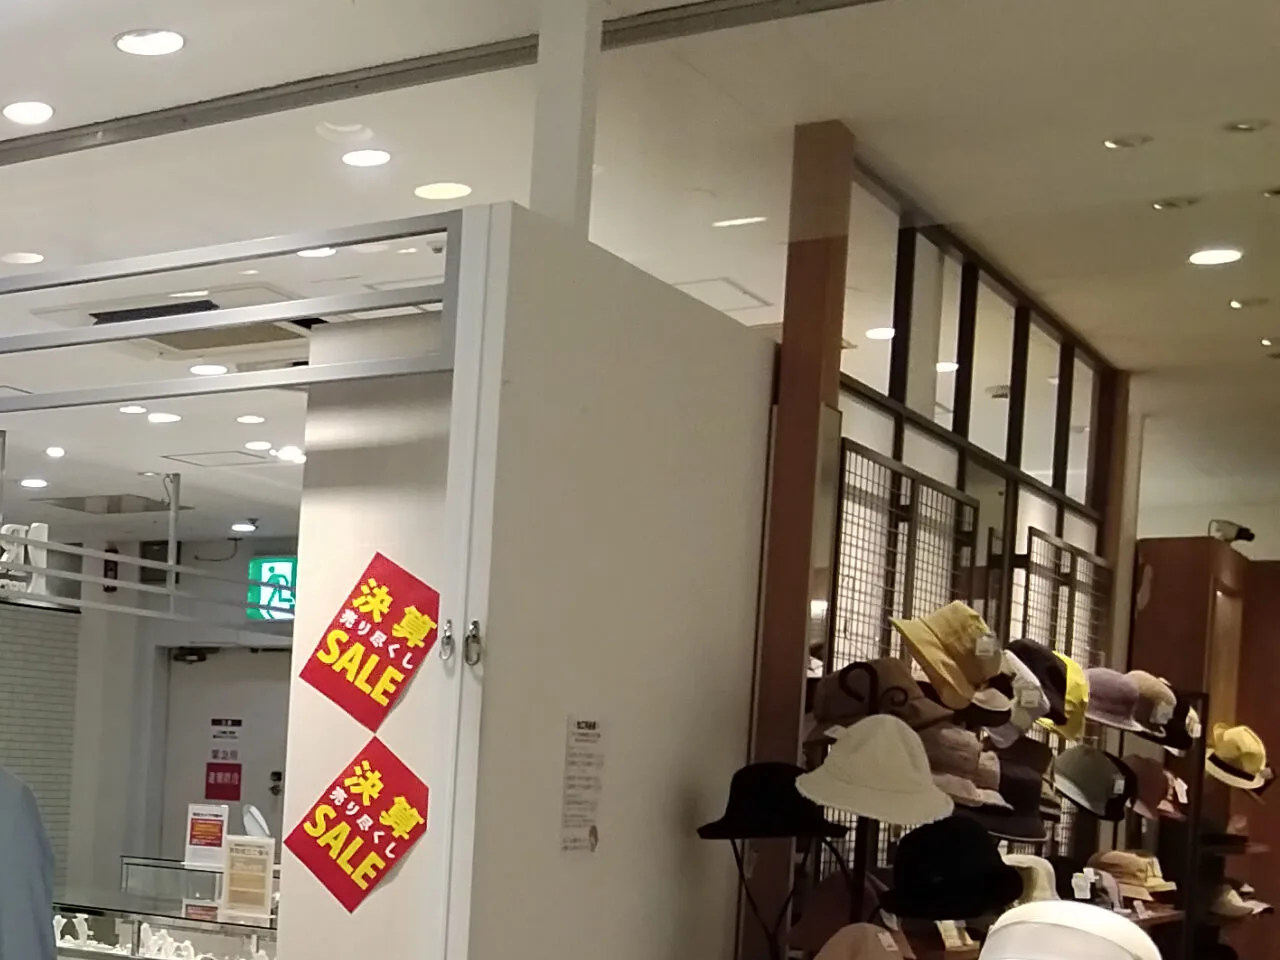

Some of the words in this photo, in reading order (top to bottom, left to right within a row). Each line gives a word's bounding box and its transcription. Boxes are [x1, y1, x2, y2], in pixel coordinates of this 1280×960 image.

[339, 608, 414, 670] 売り尽くし
[352, 577, 438, 649] 決算
[316, 629, 406, 707] SALE
[328, 785, 396, 859] 売り尽くし
[343, 759, 425, 840] 決算
[302, 804, 386, 890] SALE
